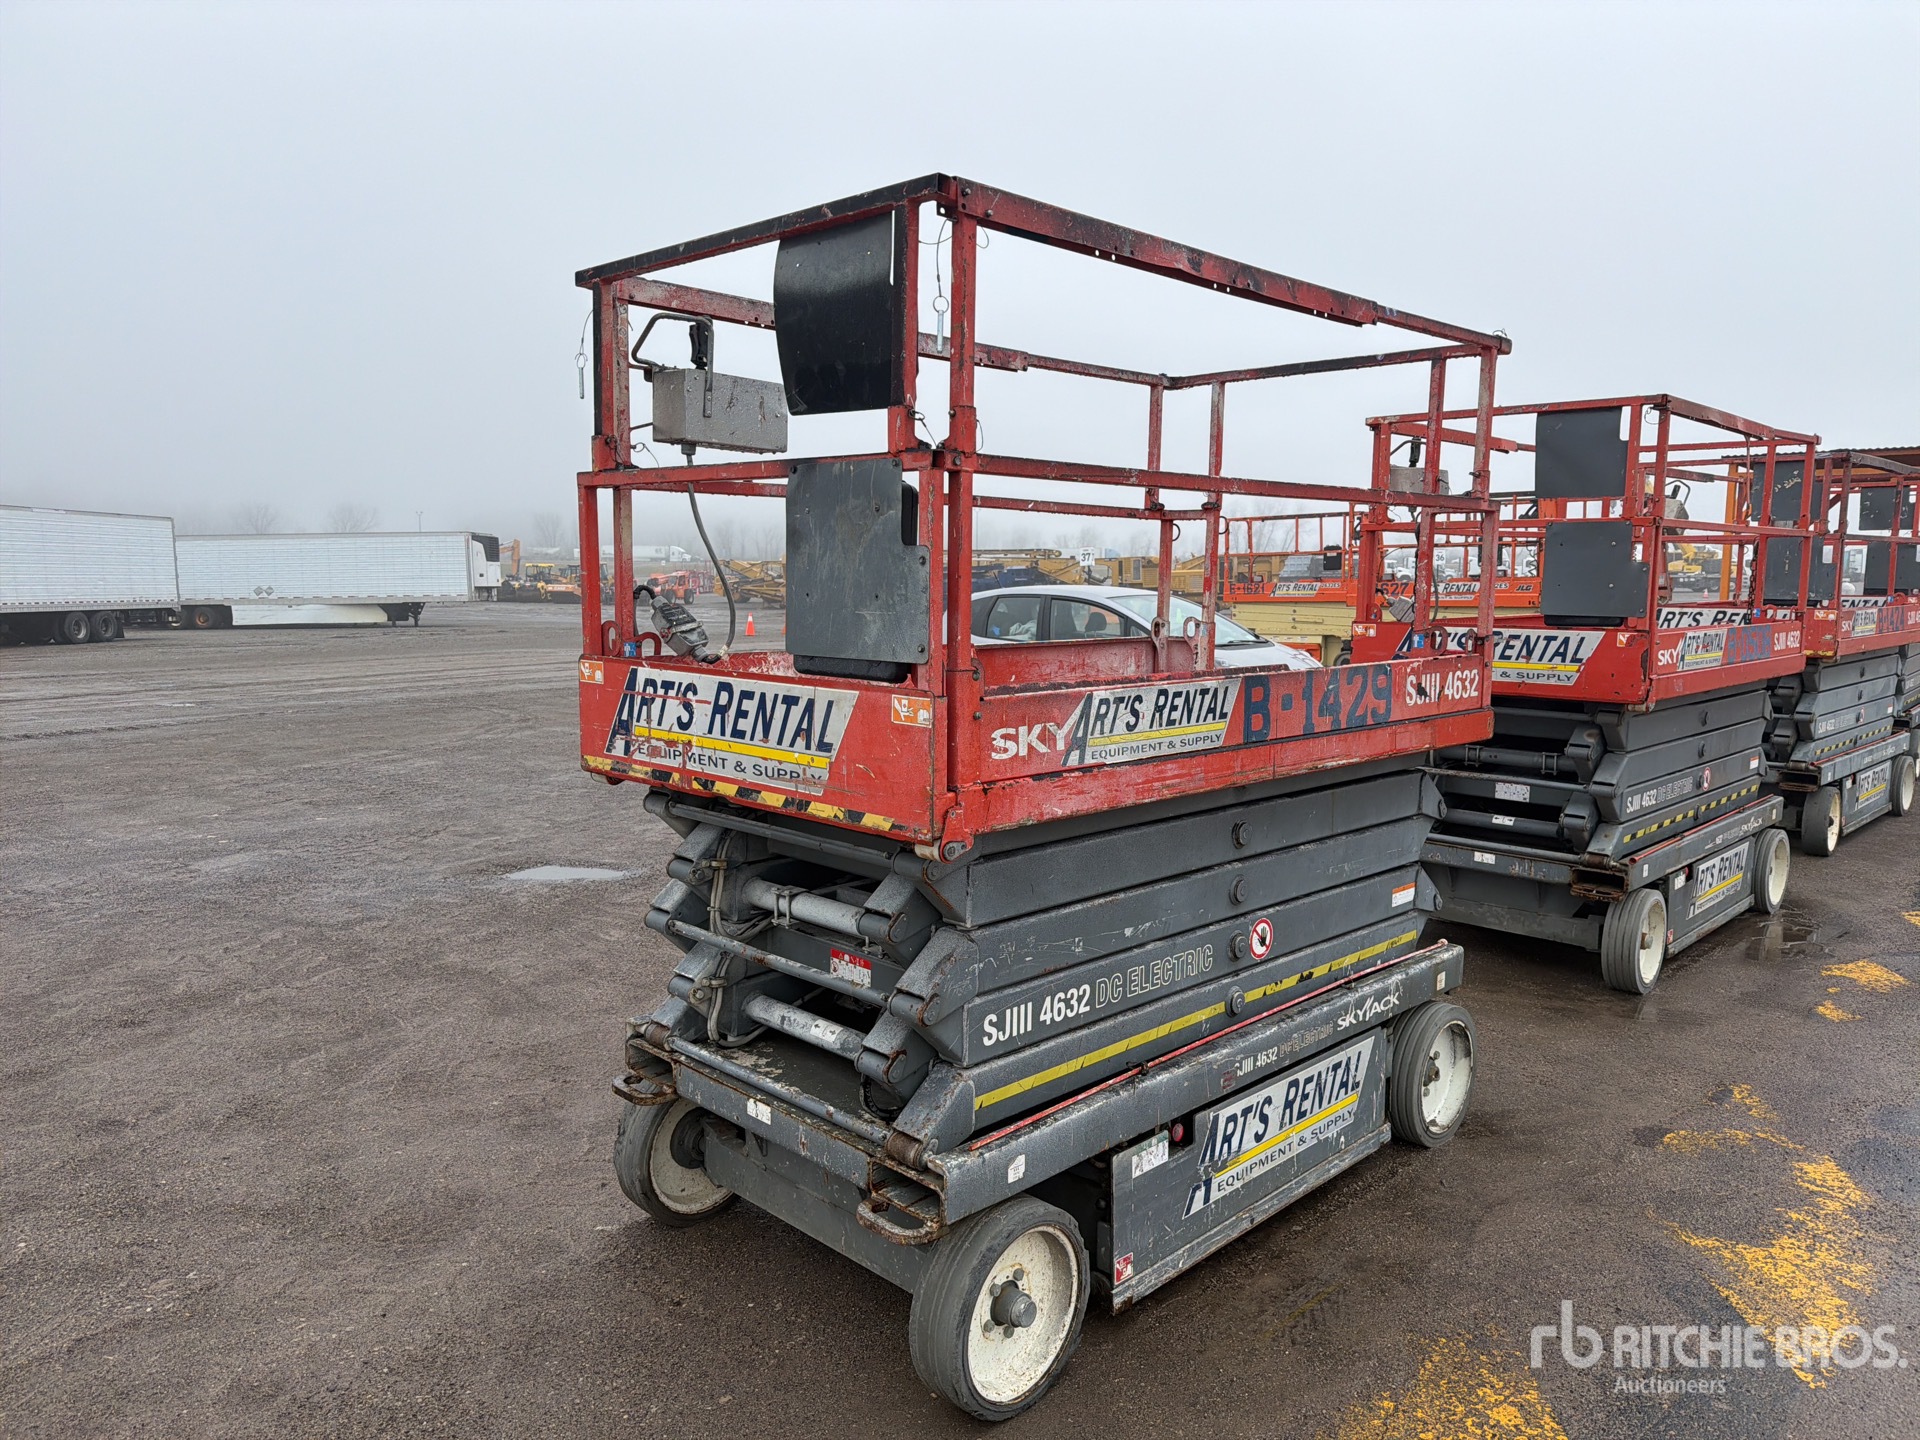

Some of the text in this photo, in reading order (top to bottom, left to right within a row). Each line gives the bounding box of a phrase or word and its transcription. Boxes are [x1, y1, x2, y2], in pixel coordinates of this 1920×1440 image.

[1081, 552, 1091, 562] 37
[1435, 554, 1445, 562] 36
[1269, 582, 1319, 597] ART'S RENTAL
[1442, 583, 1477, 593] RENTAL
[1515, 584, 1533, 592] JLG
[1787, 630, 1801, 649] 4632
[1657, 643, 1680, 666] SKY
[1444, 668, 1479, 701] 4632
[1500, 671, 1575, 682] & SUPPLY
[605, 667, 835, 757] ART'S RENTAL
[1061, 685, 1230, 767] ART'S RENTAL
[1091, 732, 1223, 761] EQUIPMENT & SUPPLY
[638, 743, 823, 785] EIPMENT & SUPPY
[1641, 788, 1657, 808] 4632
[982, 944, 1214, 1047] SJIII 4632 DC ELECTRIC
[1337, 991, 1400, 1031] SKYJACK
[1256, 1046, 1278, 1069] 4632
[1183, 1094, 1273, 1217] ART'S
[1278, 1050, 1363, 1132] RENTAL
[1217, 1108, 1355, 1193] EQUIPMENT & SUPPLY
